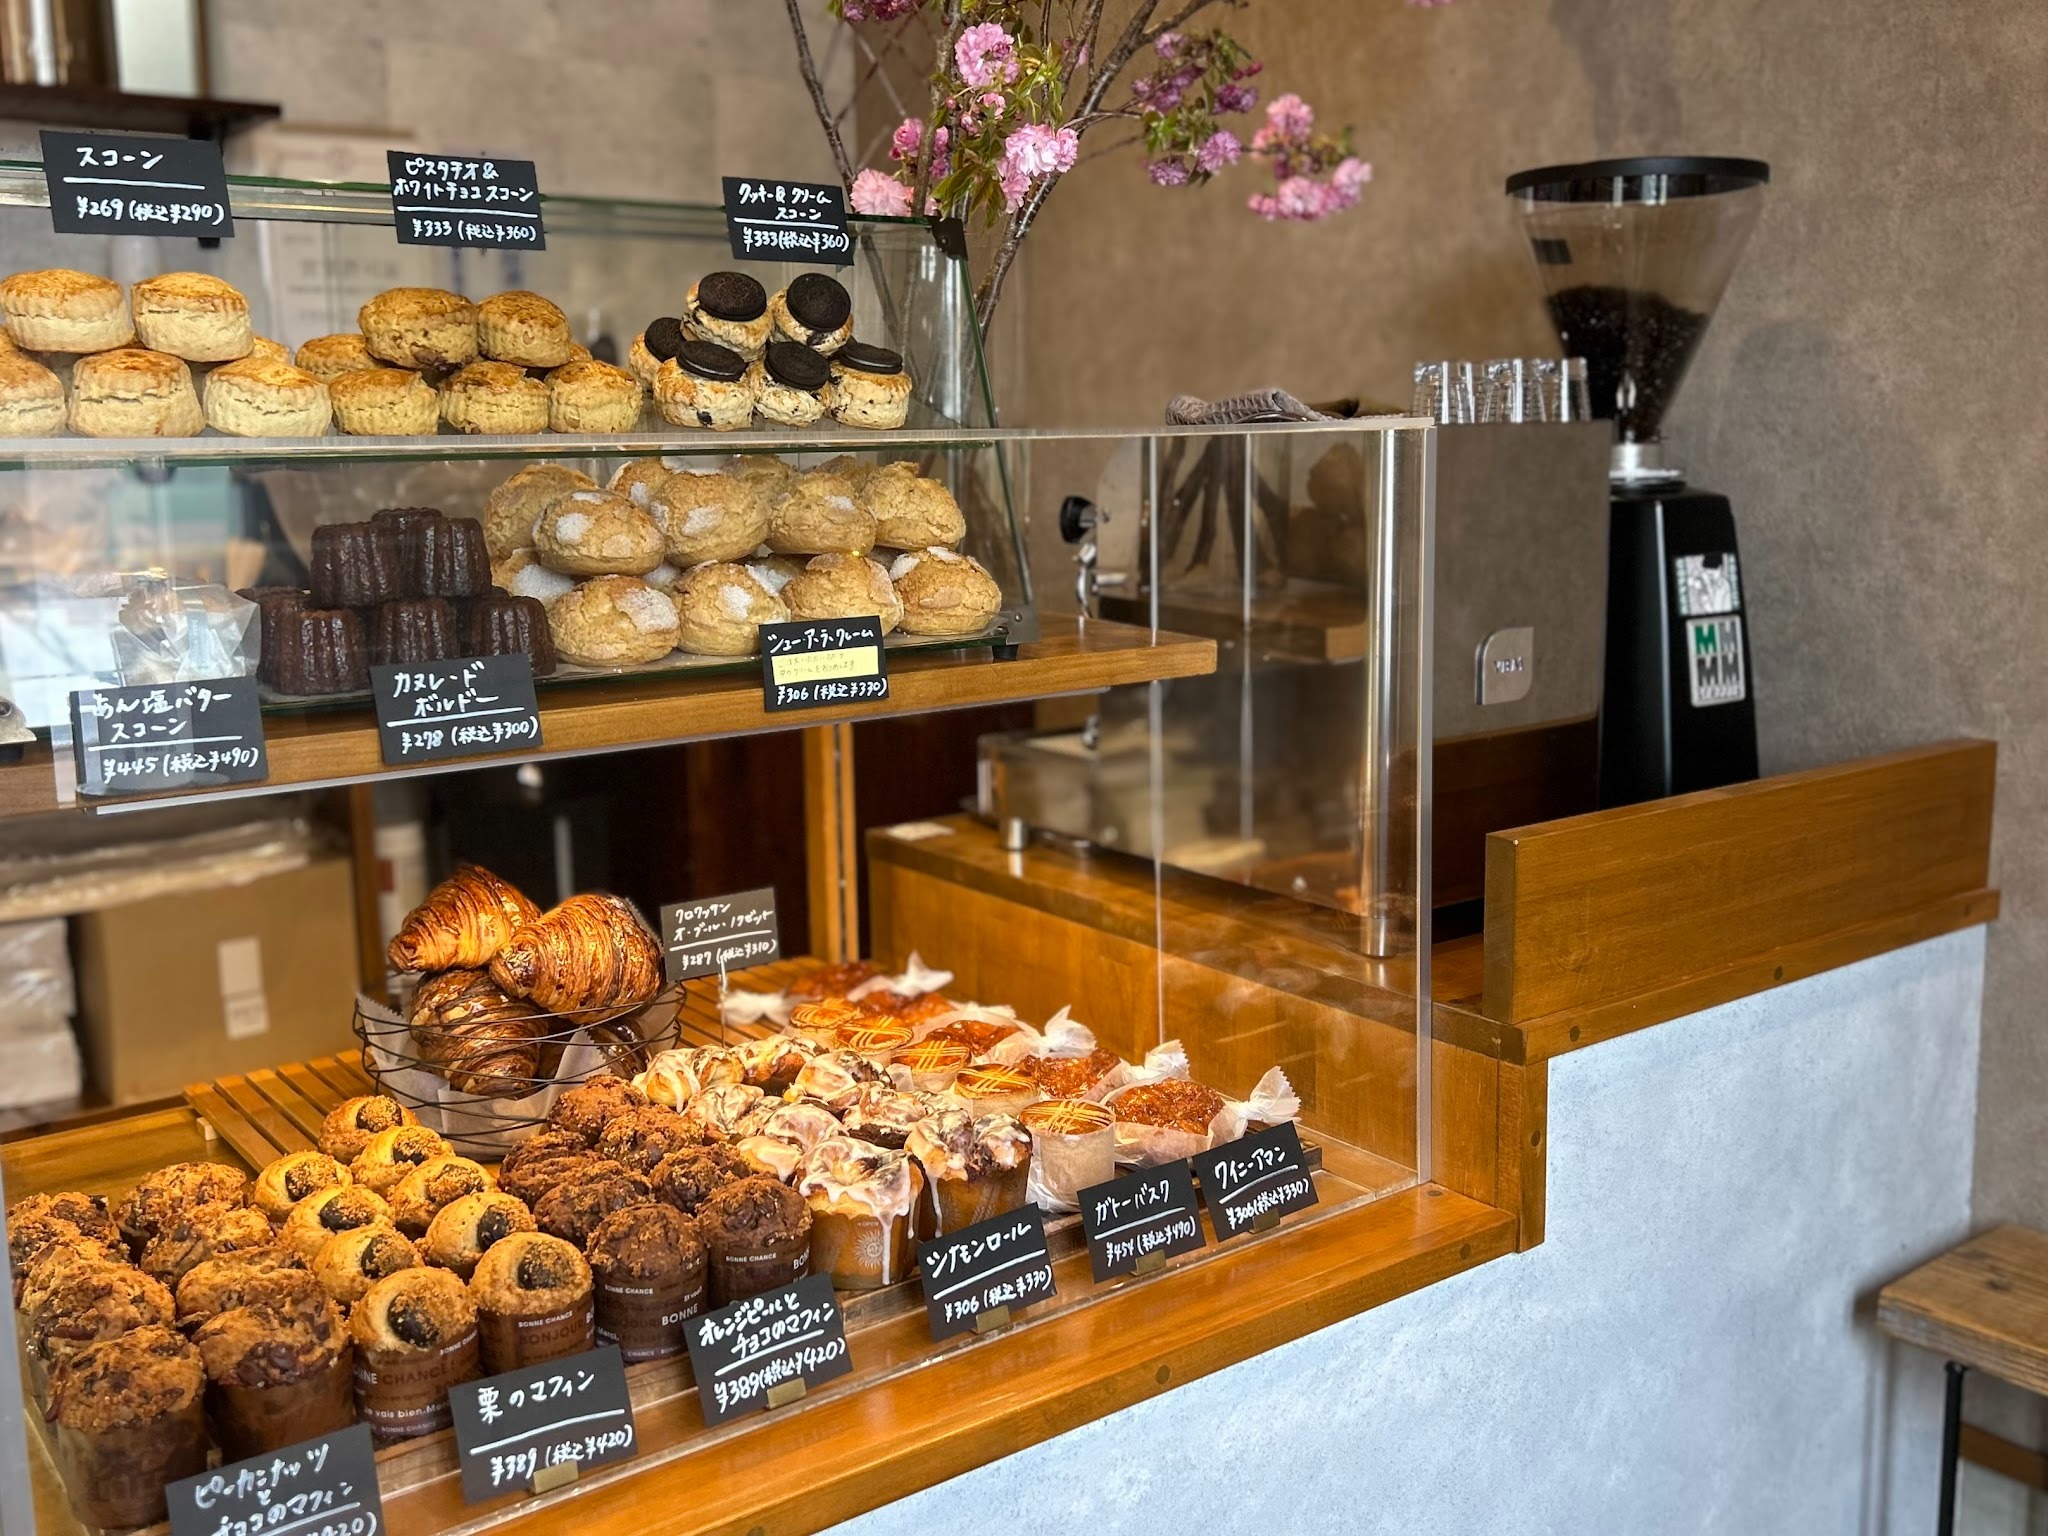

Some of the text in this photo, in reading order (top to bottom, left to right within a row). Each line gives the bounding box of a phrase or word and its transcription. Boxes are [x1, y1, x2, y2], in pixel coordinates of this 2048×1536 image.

[76, 147, 164, 170] スコーン
[775, 206, 822, 221] スコーン
[92, 685, 232, 720] あん塩バター
[414, 688, 500, 718] ボルドー
[110, 717, 188, 743] スコーン
[675, 902, 732, 924] クロワッサン
[1095, 1179, 1170, 1227] ガトーバスク
[725, 1252, 777, 1263] BONNE CHANCE
[926, 1222, 1032, 1279] シナモンロール
[624, 1286, 654, 1295] CHANCE
[518, 1318, 544, 1328] BONNE
[545, 1309, 574, 1324] CHANCE
[661, 1303, 699, 1327] BONNE
[698, 1292, 801, 1347] オレンジピールと
[730, 1302, 835, 1360] チョコのマフィン
[477, 1369, 596, 1425] 栗のマフィン
[376, 1409, 395, 1418] vais
[194, 1442, 330, 1510] ピーカンナッツ
